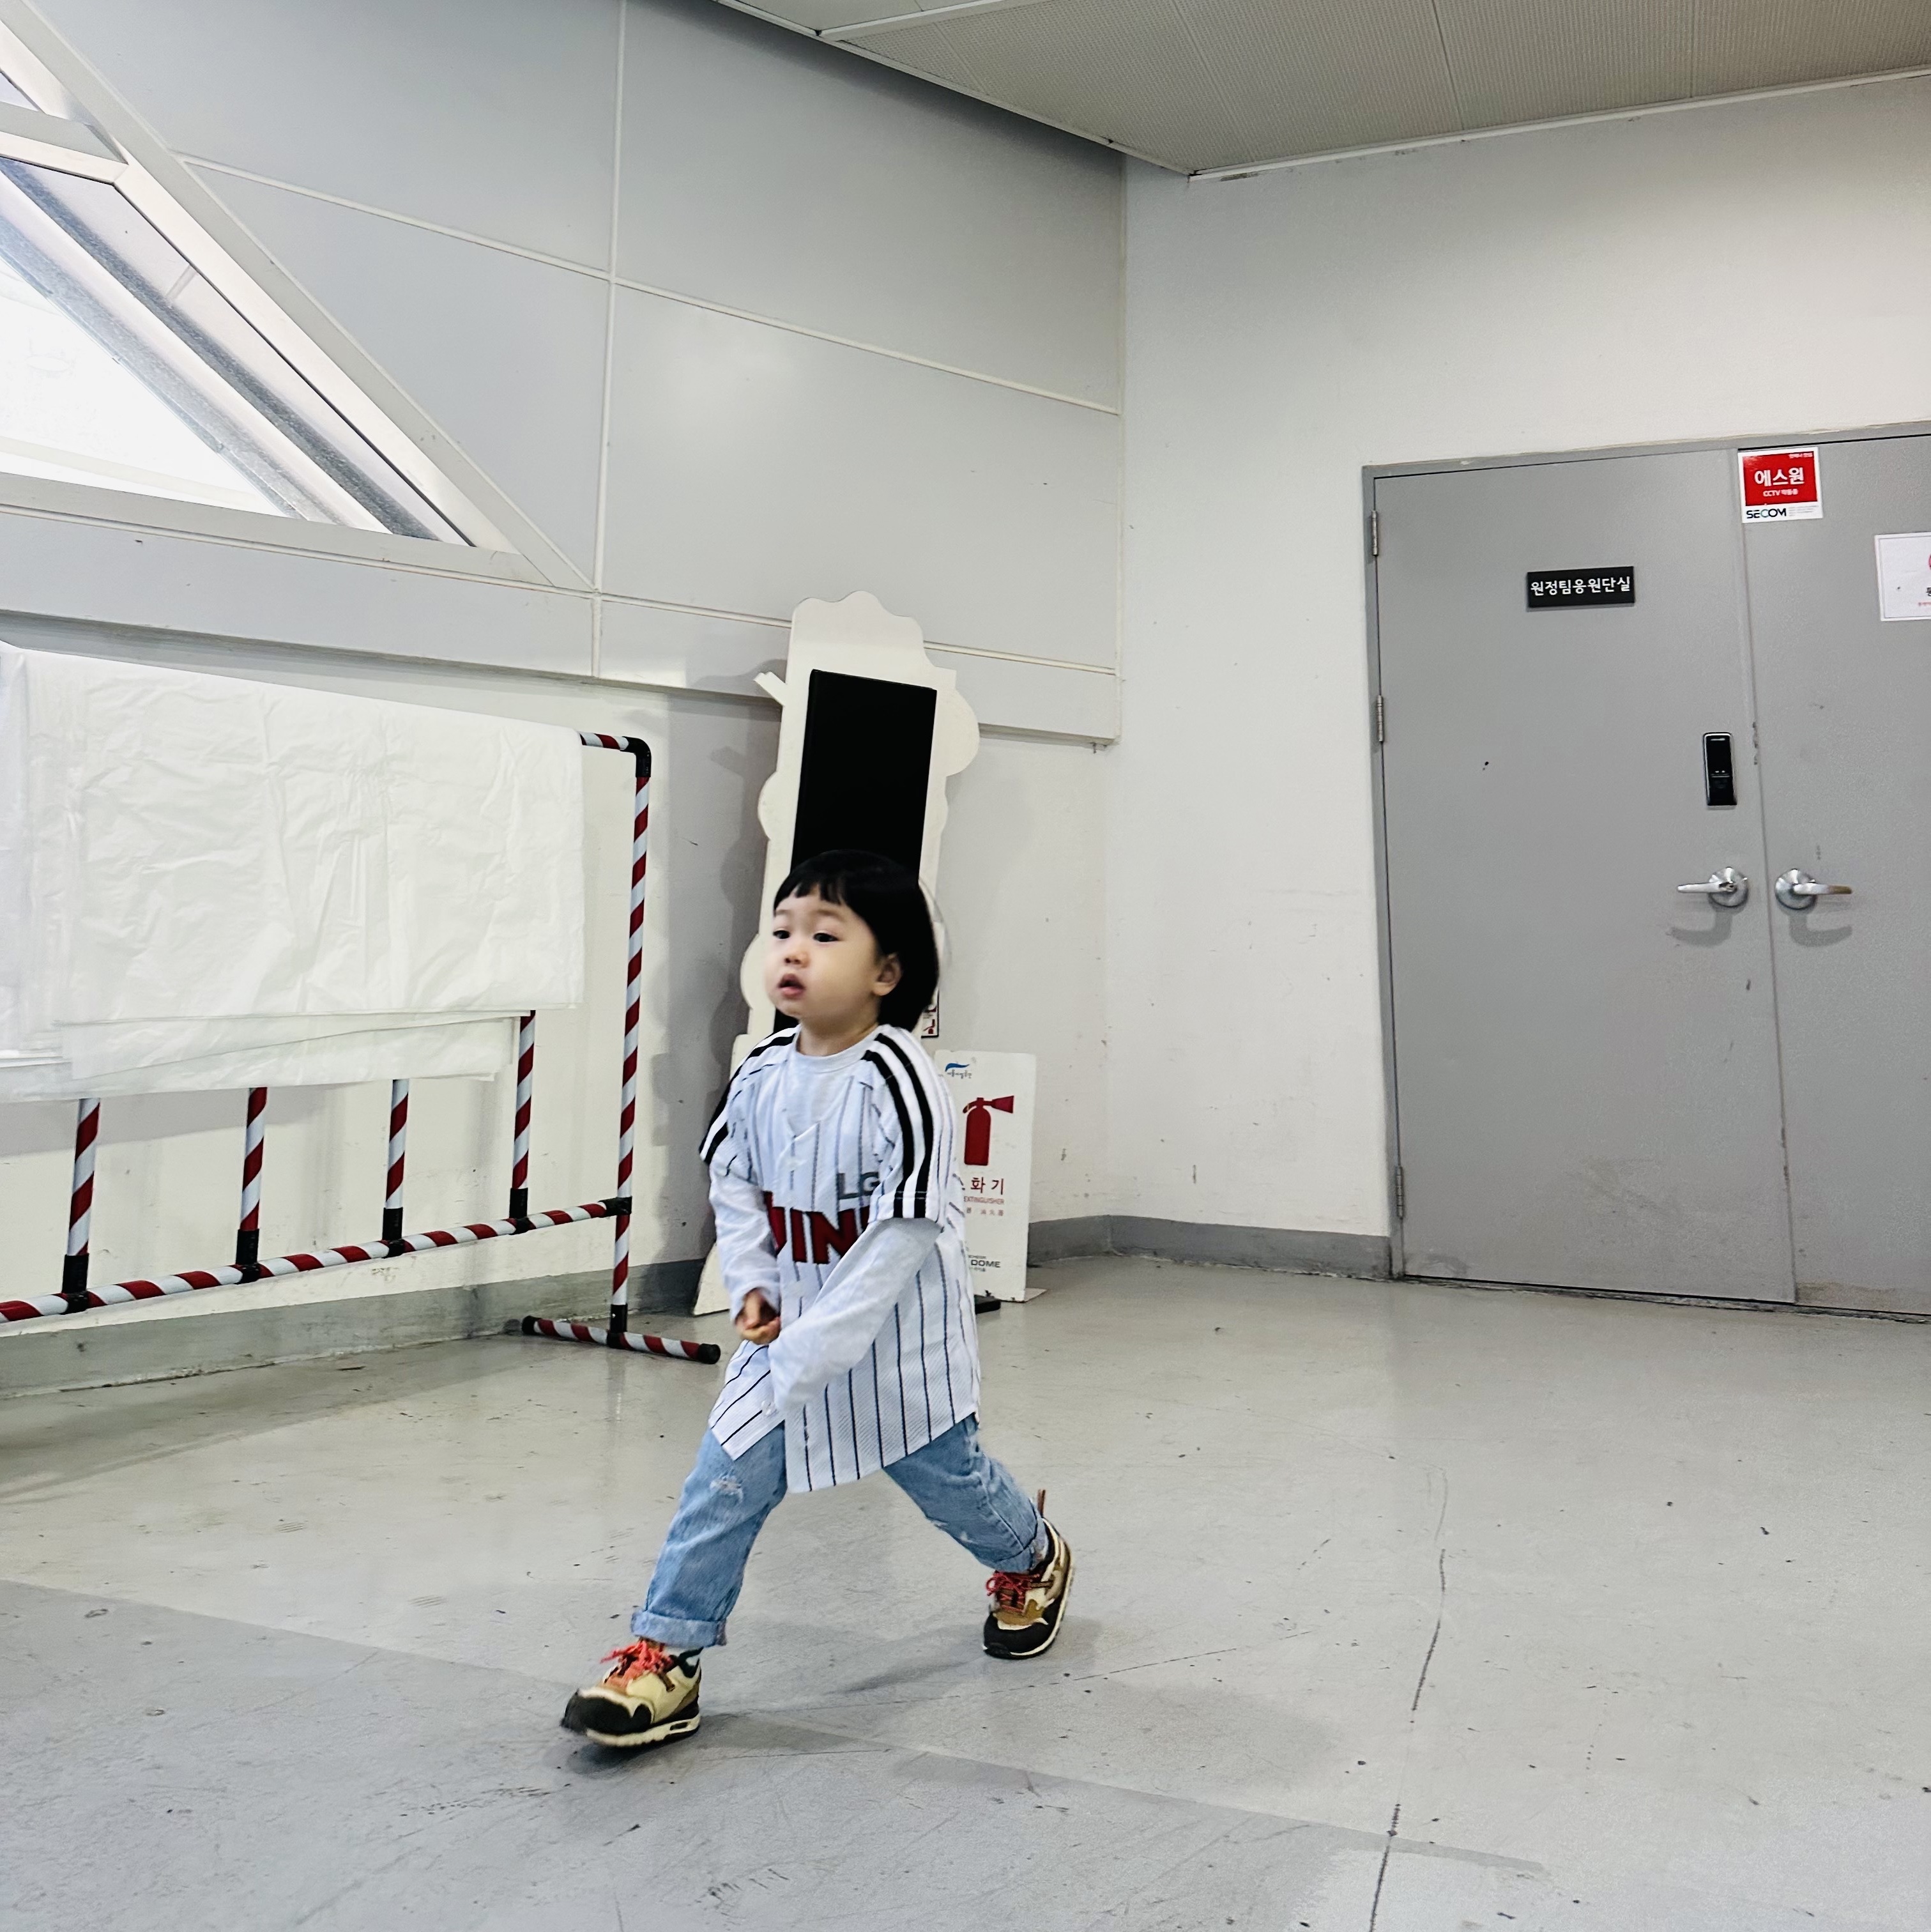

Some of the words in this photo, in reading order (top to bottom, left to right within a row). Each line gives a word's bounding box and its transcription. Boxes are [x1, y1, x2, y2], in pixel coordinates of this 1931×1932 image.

[1754, 467, 1805, 487] 에스원
[1746, 508, 1787, 519] SECOM
[1530, 576, 1630, 596] 원정팀응원단실
[961, 1176, 1004, 1195] 화기
[971, 1259, 1001, 1268] DOME
